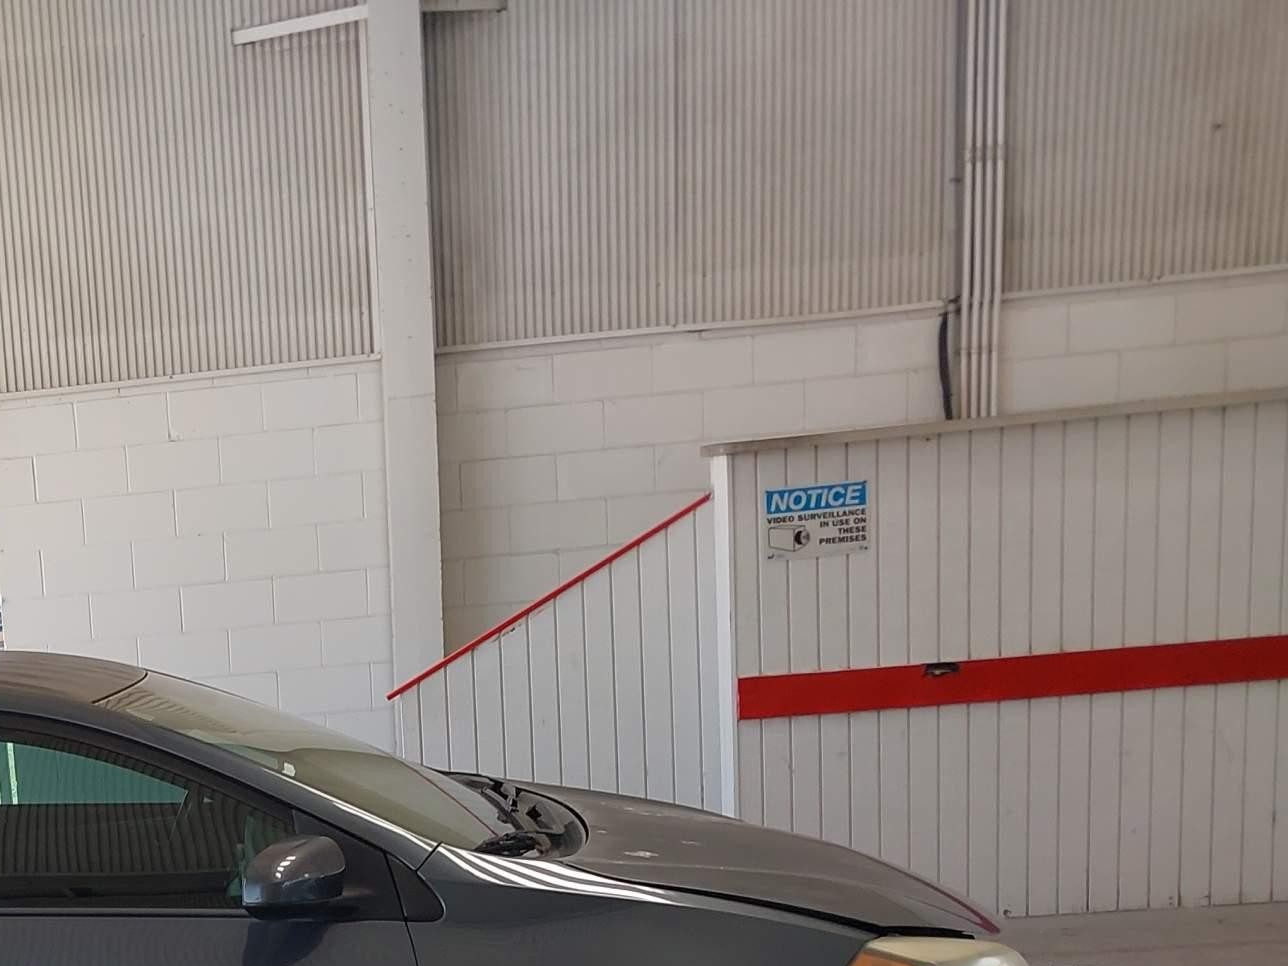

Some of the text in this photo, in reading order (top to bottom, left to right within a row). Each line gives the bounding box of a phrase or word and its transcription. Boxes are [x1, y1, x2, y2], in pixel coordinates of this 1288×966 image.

[770, 485, 863, 512] NOTICE
[767, 508, 867, 525] VIDEO SURVEILLANCE
[819, 517, 867, 528] IN USE ON
[838, 526, 867, 535] THESE
[819, 534, 867, 545] PREMISES
